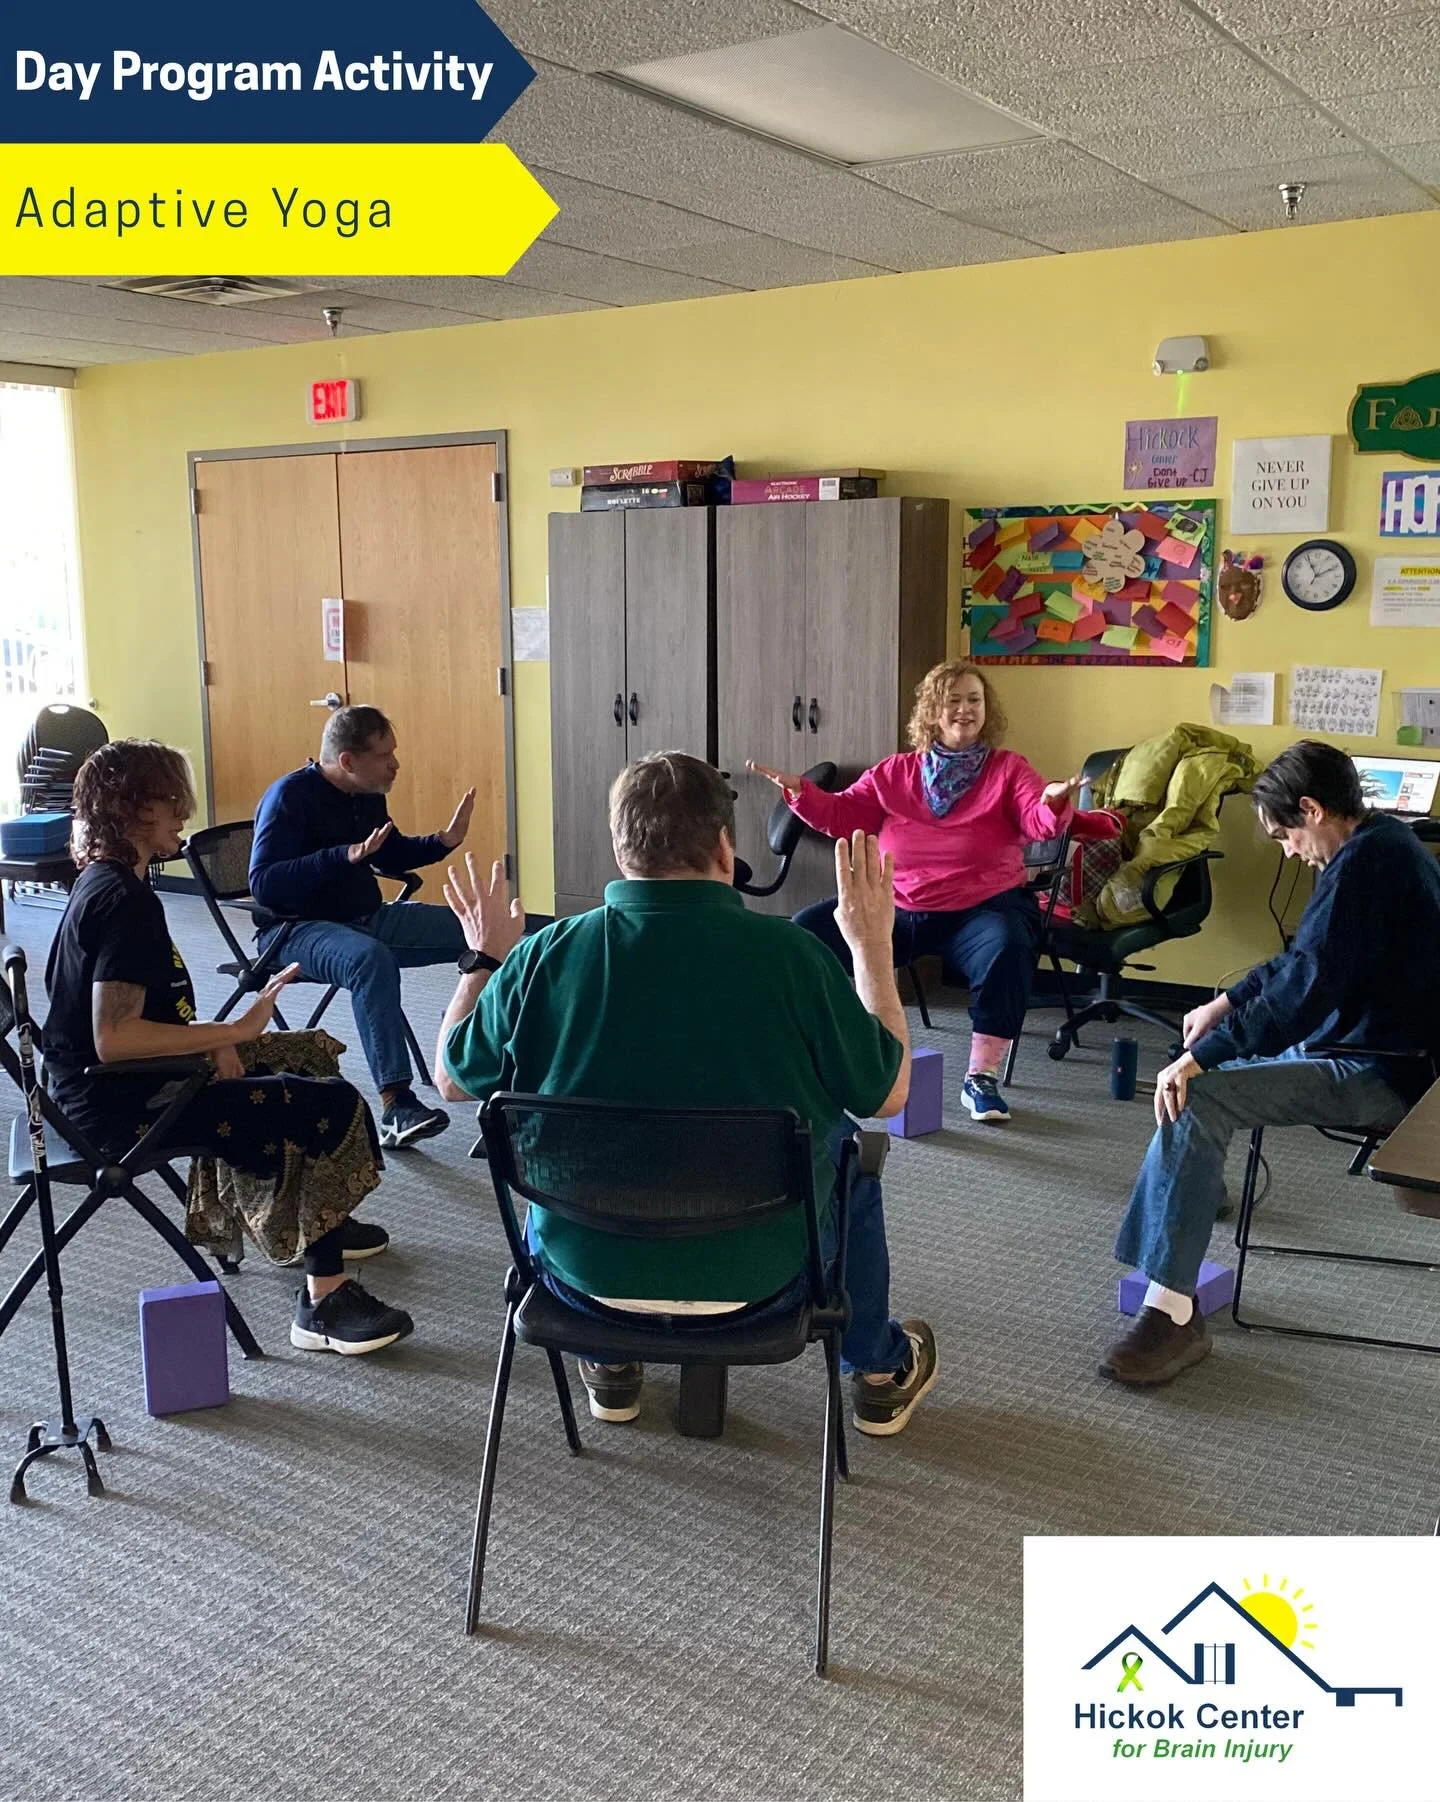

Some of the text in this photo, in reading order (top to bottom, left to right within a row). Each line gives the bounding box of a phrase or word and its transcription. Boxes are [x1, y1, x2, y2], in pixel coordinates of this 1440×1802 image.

[313, 381, 347, 420] EXIT
[609, 464, 653, 482] SCRABBLE
[1256, 460, 1305, 474] NEVER
[1251, 478, 1310, 491] GIVE UP
[781, 492, 810, 501] HOCKEY
[1252, 495, 1307, 510] ON YOU
